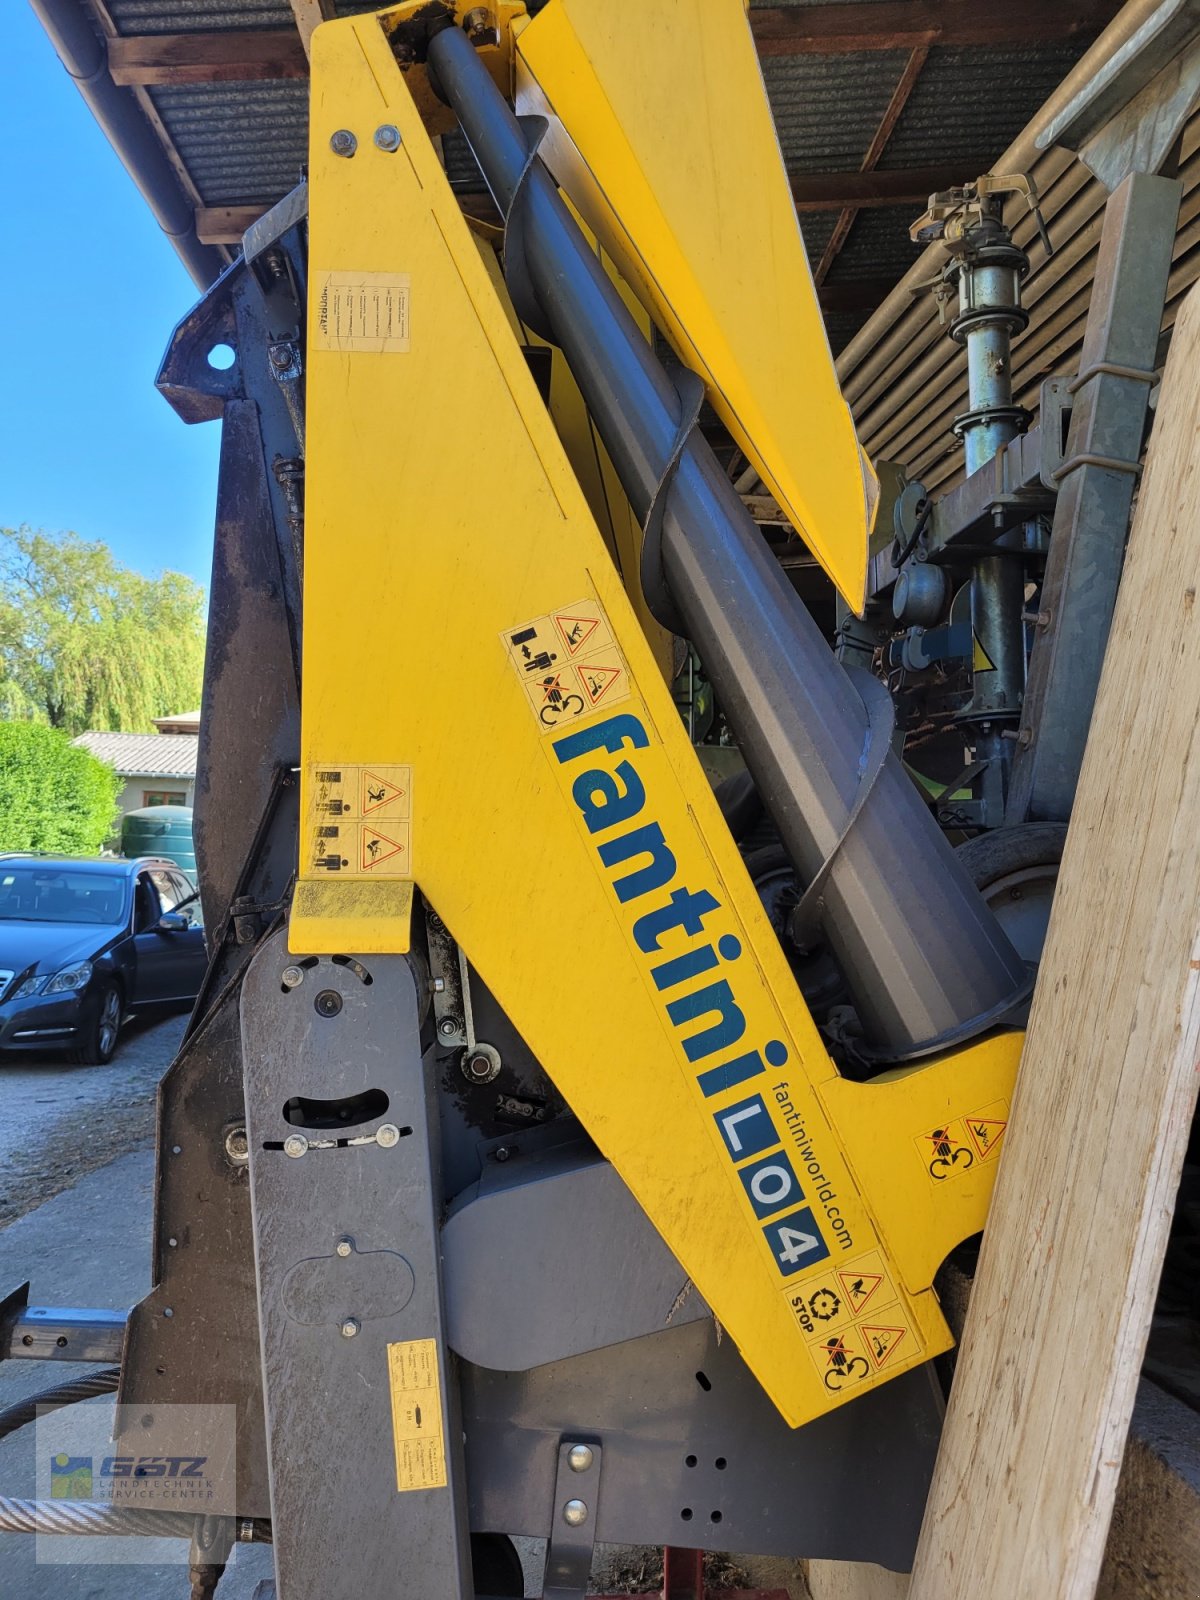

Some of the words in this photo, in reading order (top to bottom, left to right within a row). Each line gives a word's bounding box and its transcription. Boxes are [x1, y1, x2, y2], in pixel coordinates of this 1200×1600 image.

[551, 713, 789, 1099] fantini
[772, 1081, 854, 1250] fantiniworld.com
[791, 1296, 815, 1333] STOP
